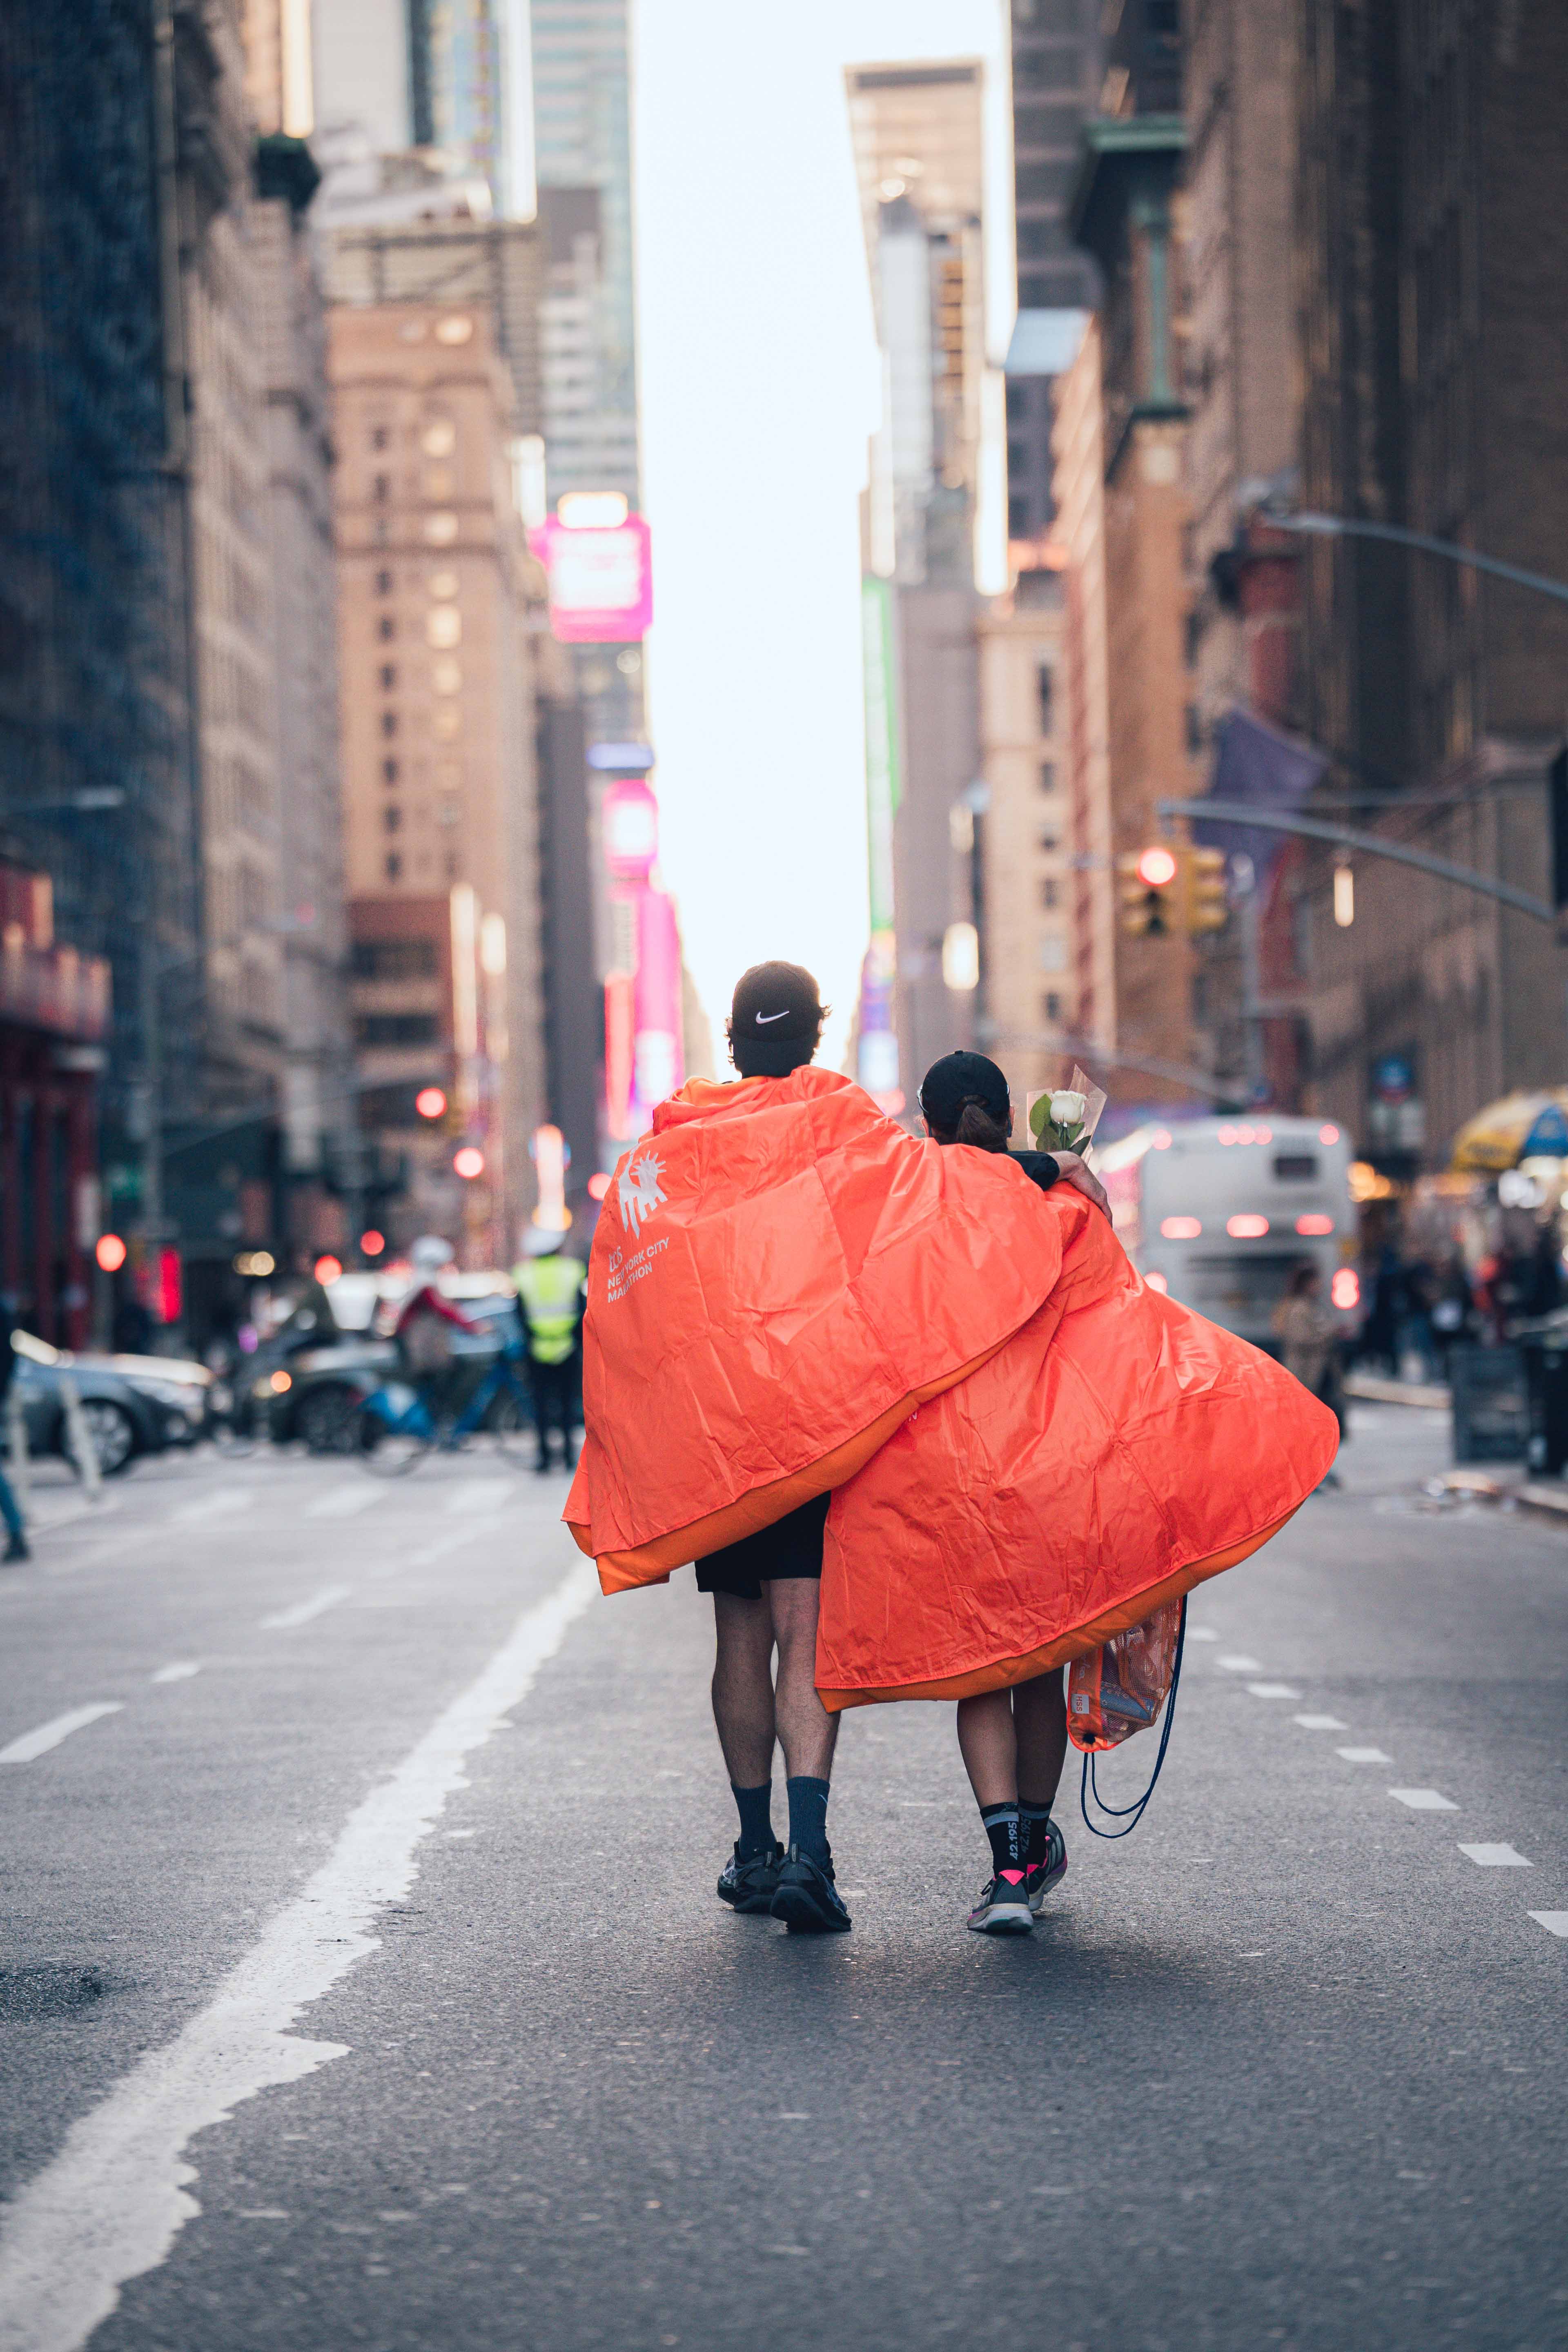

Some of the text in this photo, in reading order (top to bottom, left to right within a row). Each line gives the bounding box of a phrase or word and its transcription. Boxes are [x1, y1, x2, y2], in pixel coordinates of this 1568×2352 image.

[625, 1250, 646, 1274] YORK
[646, 1236, 669, 1257] CITY
[608, 1262, 653, 1303] MARATHON
[1008, 1822, 1018, 1860] 42.195
